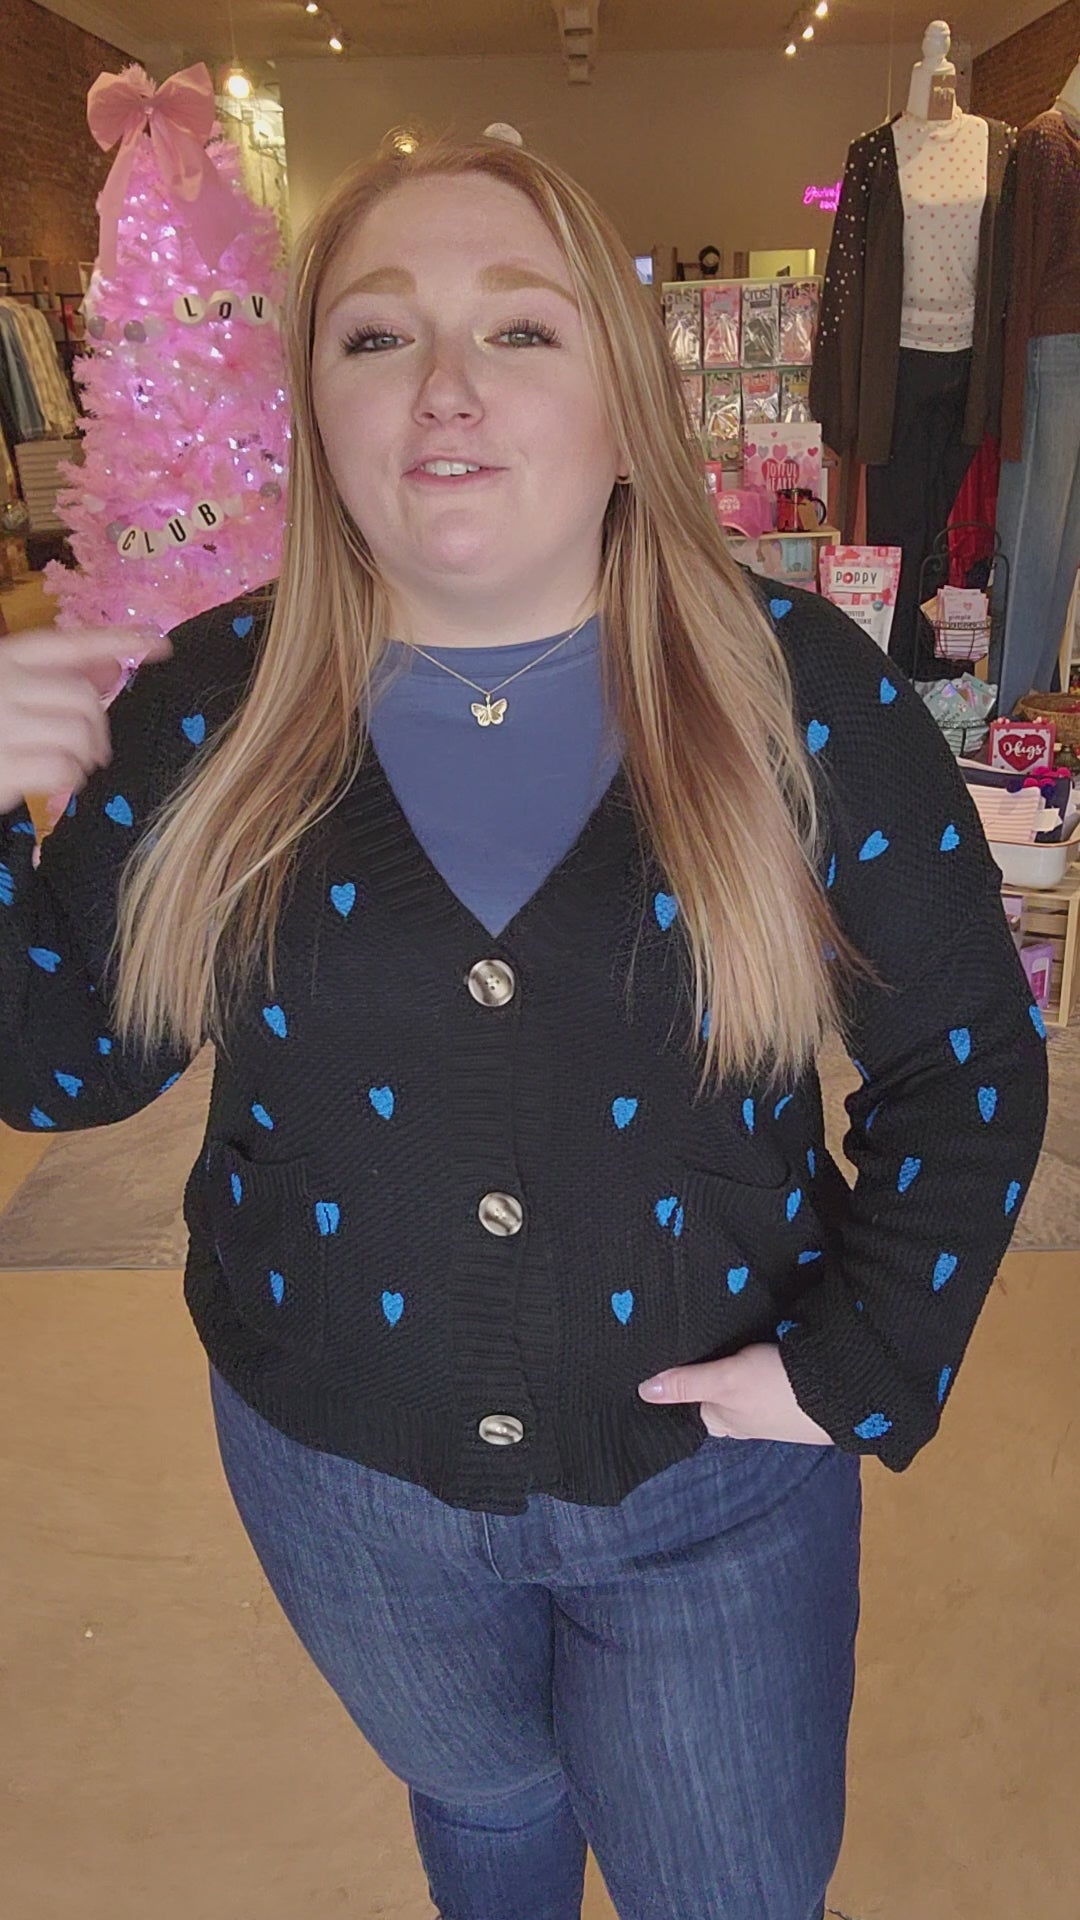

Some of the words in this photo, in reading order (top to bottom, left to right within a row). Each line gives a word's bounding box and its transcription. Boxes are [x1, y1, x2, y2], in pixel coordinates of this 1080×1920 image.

[766, 462, 797, 478] JOYFUL
[122, 503, 217, 553] CLUB
[835, 571, 878, 585] POPPY
[1003, 741, 1046, 761] Hugs
